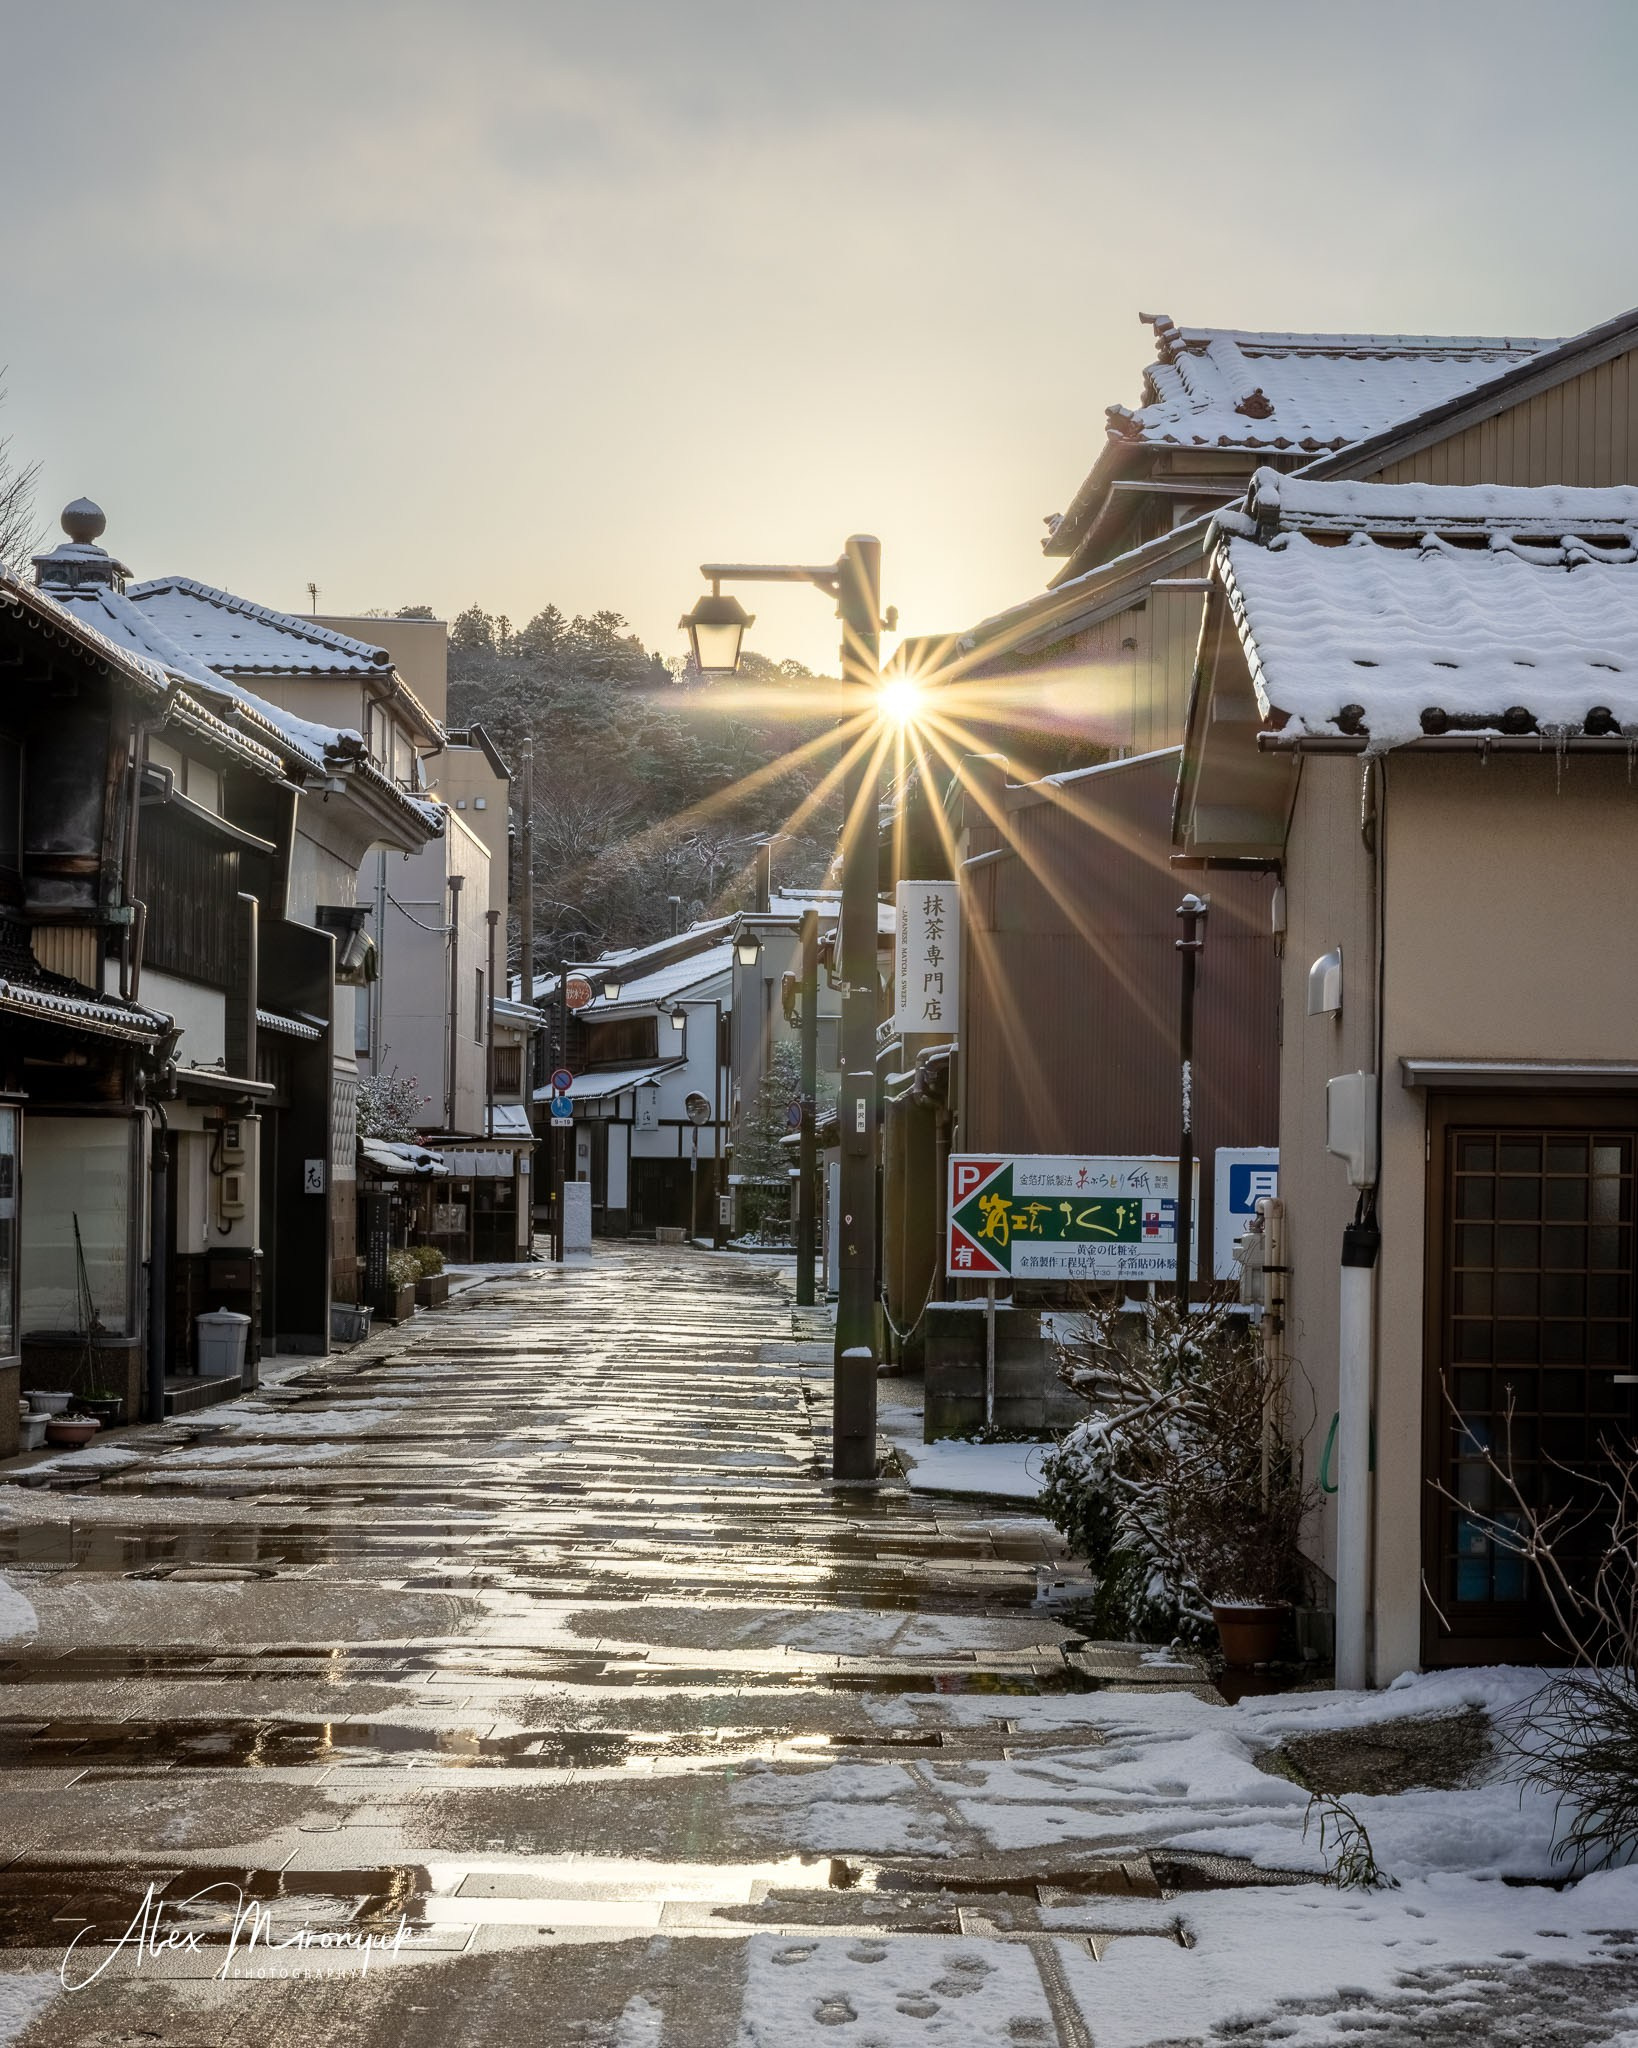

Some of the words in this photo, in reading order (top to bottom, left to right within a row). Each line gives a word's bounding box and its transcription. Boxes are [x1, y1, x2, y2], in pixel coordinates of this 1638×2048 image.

[922, 894, 946, 1021] 抹茶専門店
[857, 1103, 865, 1128] 金沢市
[958, 1166, 980, 1195] P
[1019, 1173, 1073, 1186] 金箔打紙製法
[1076, 1166, 1151, 1194] あぶらとり紙
[955, 1246, 974, 1267] 有
[1077, 1244, 1138, 1256] 黄金の化粧室
[1019, 1256, 1096, 1268] 金箔製作工程見学
[1117, 1257, 1177, 1270] 金箔貼り体験
